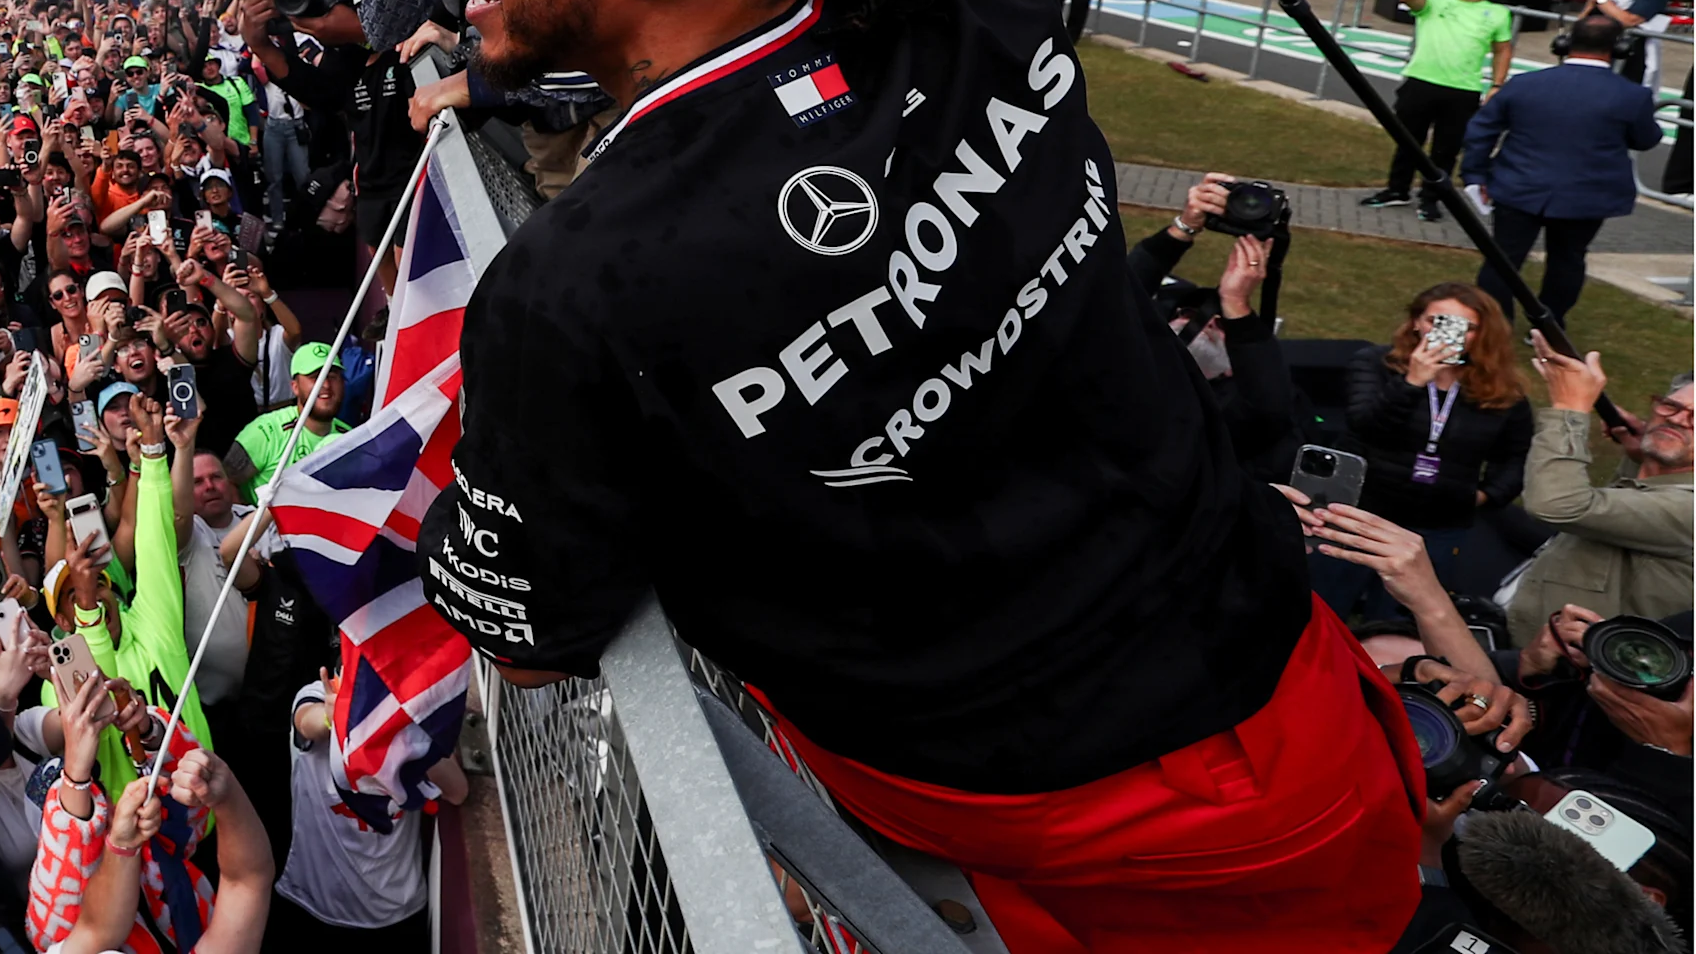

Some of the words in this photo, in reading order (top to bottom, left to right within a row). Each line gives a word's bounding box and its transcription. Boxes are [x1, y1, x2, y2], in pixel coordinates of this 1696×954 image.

[774, 54, 833, 84] TOMMY
[798, 94, 854, 125] HILFIGER
[710, 36, 1078, 440] PETRONAS
[849, 157, 1114, 468] CROWDSTRIKE
[428, 555, 528, 622] PIRELLI
[433, 592, 503, 636] AMD
